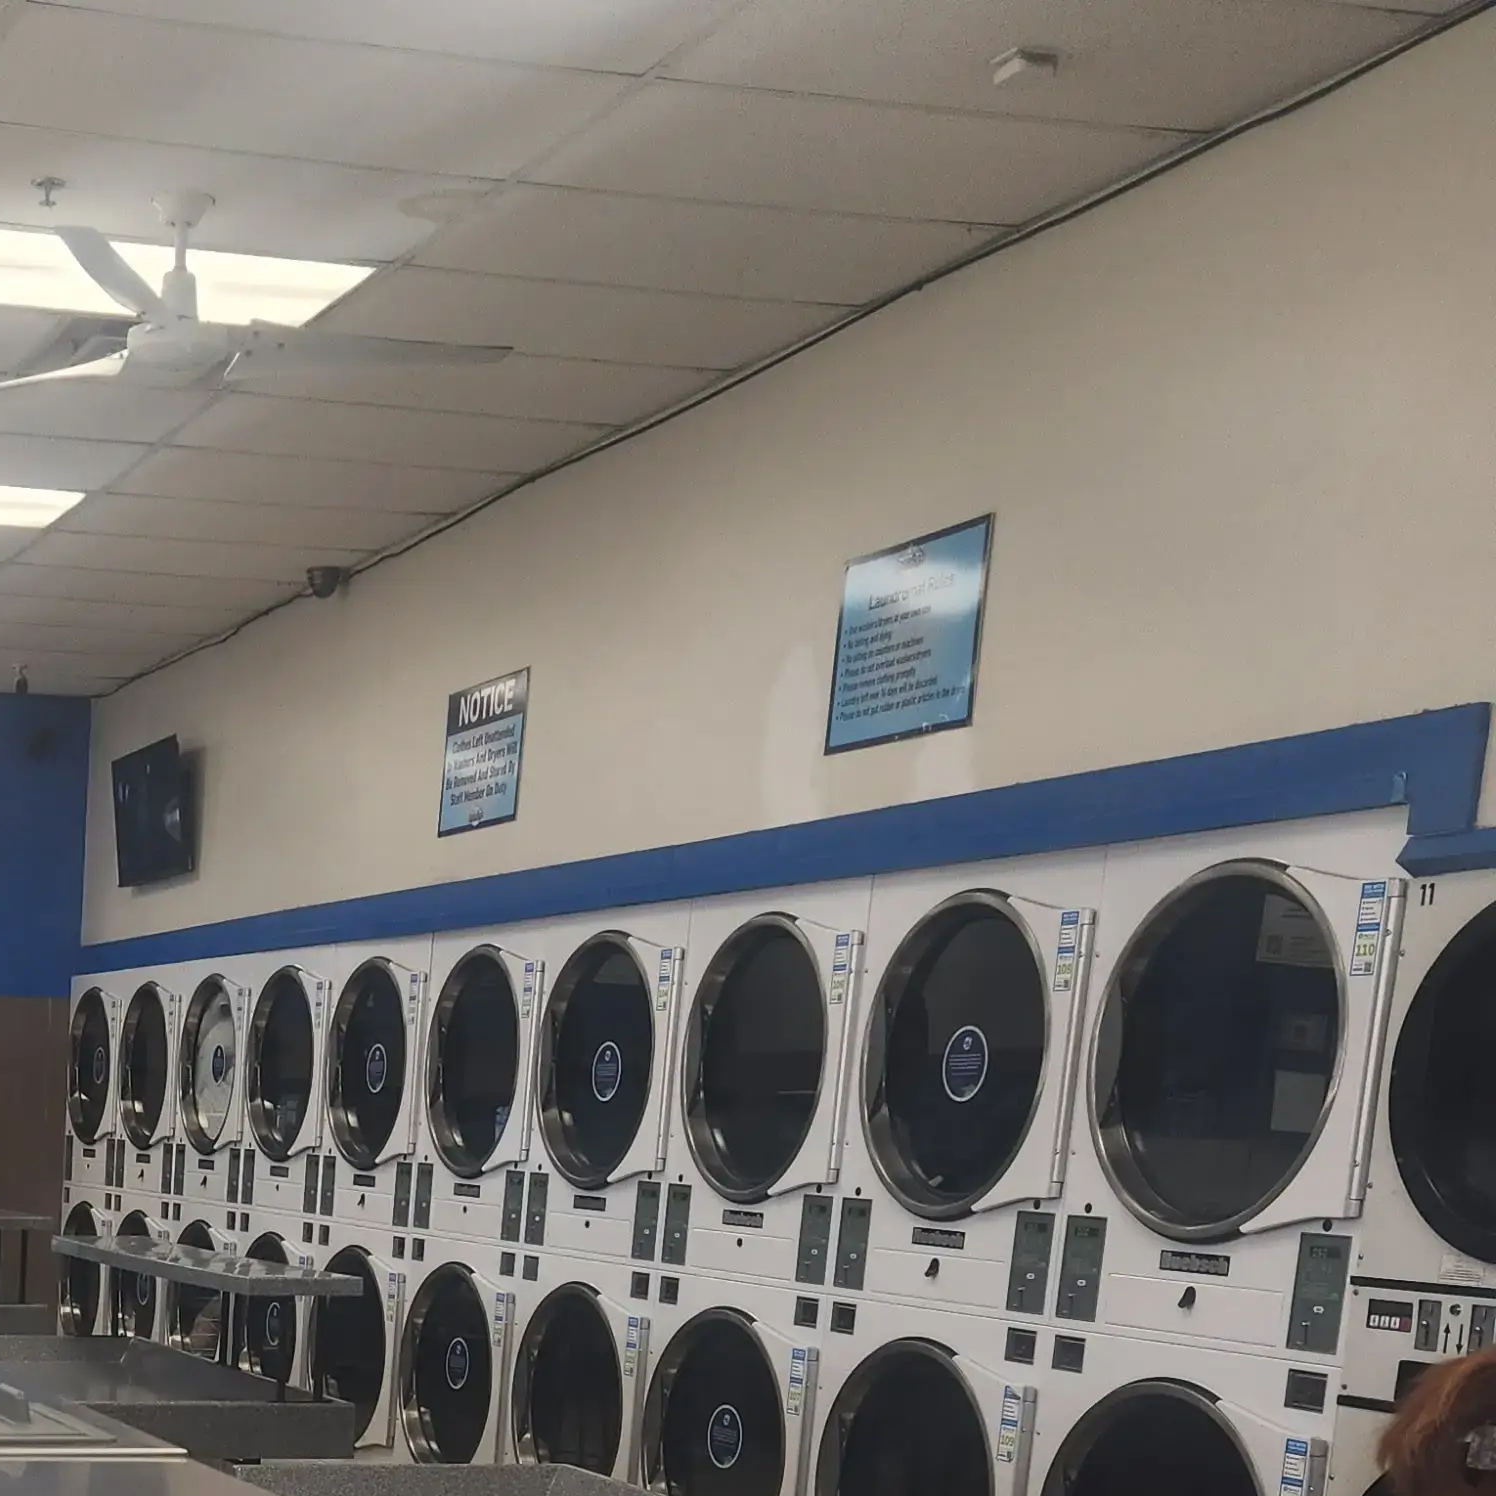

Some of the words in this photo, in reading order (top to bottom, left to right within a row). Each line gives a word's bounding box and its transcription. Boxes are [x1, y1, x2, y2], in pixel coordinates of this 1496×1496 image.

[459, 679, 516, 727] NOTICE
[1420, 882, 1436, 906] 11
[1356, 943, 1376, 957] 110
